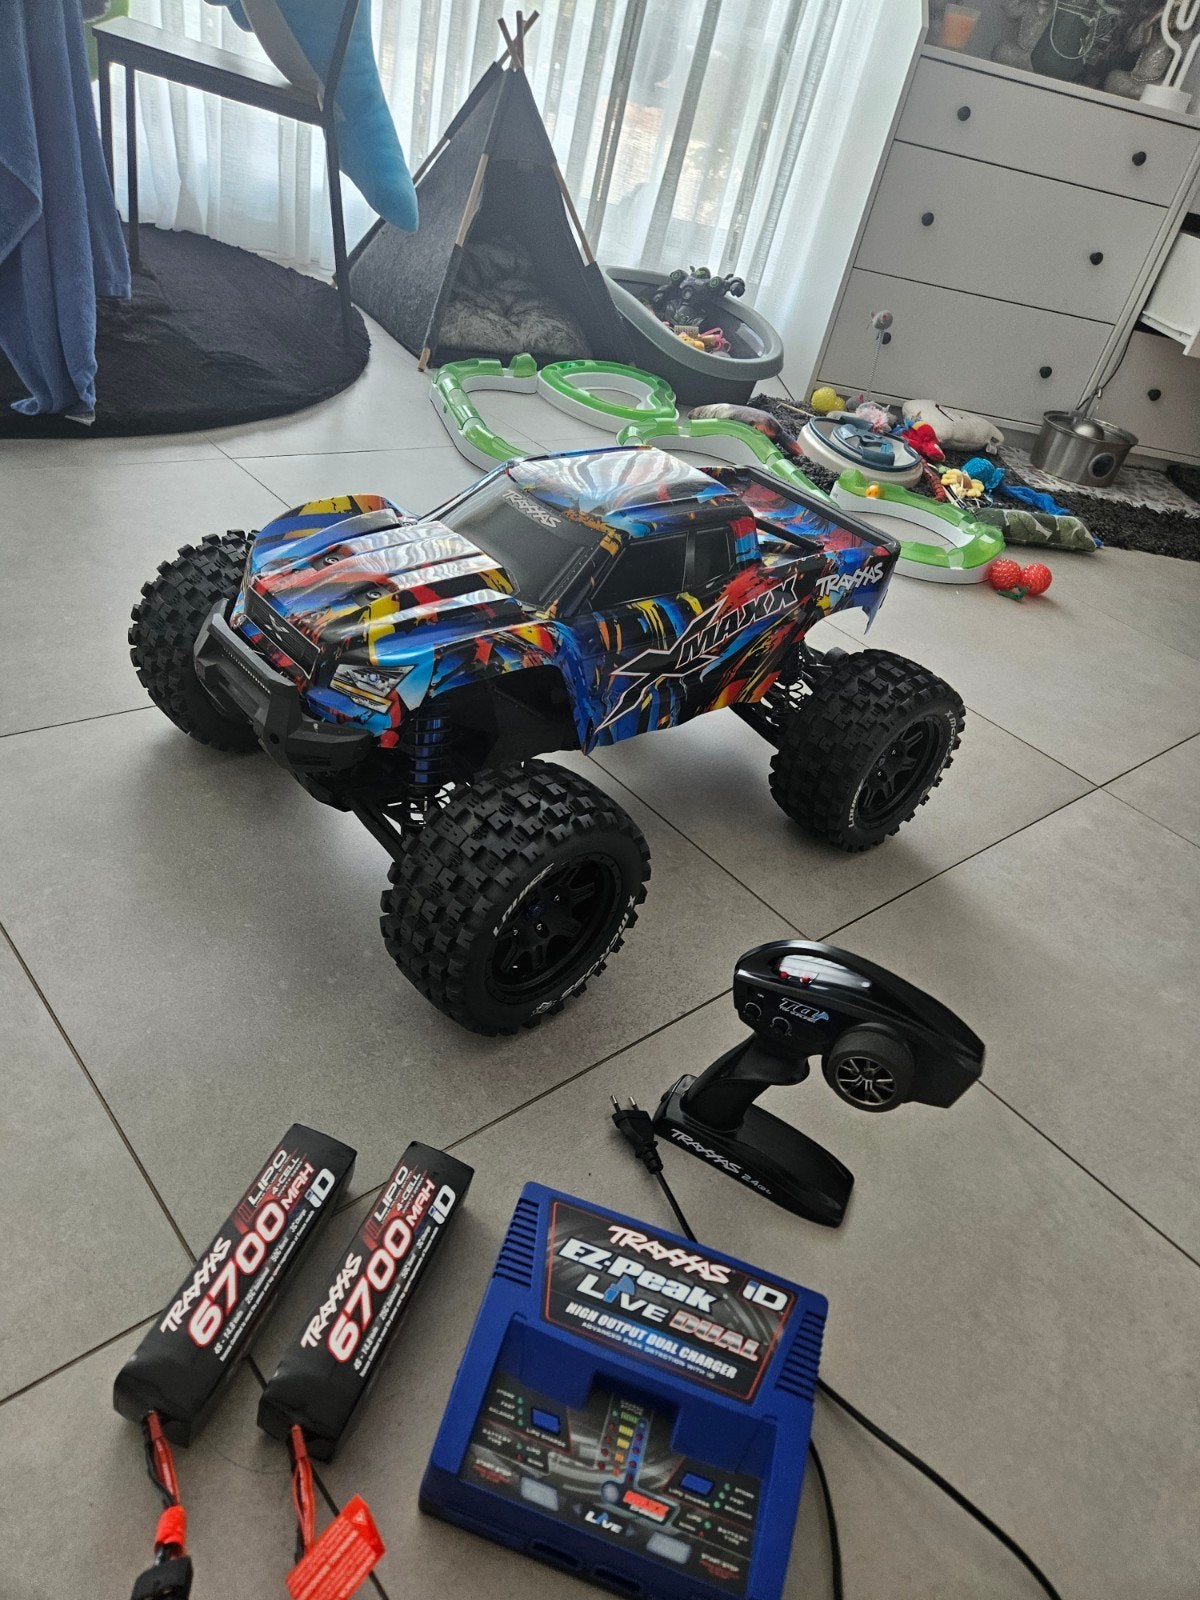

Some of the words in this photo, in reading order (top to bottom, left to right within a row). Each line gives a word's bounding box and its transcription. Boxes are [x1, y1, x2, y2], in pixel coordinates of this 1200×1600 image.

[503, 489, 561, 528] TRAXXAS
[816, 562, 884, 596] TRAXXAS
[671, 1128, 741, 1174] TRAXXAS
[160, 1237, 232, 1333] TRAXXAS
[188, 1201, 286, 1346] 6700
[607, 1225, 731, 1284] TRAXXAS
[300, 1252, 362, 1348] TRAXXAS
[328, 1218, 412, 1361] 6700
[565, 1301, 599, 1323] HIGH
[597, 1311, 649, 1343] OUTPUT
[646, 1331, 680, 1355] DUAL
[679, 1346, 738, 1379] CHARGER
[669, 1309, 760, 1362] DUAL
